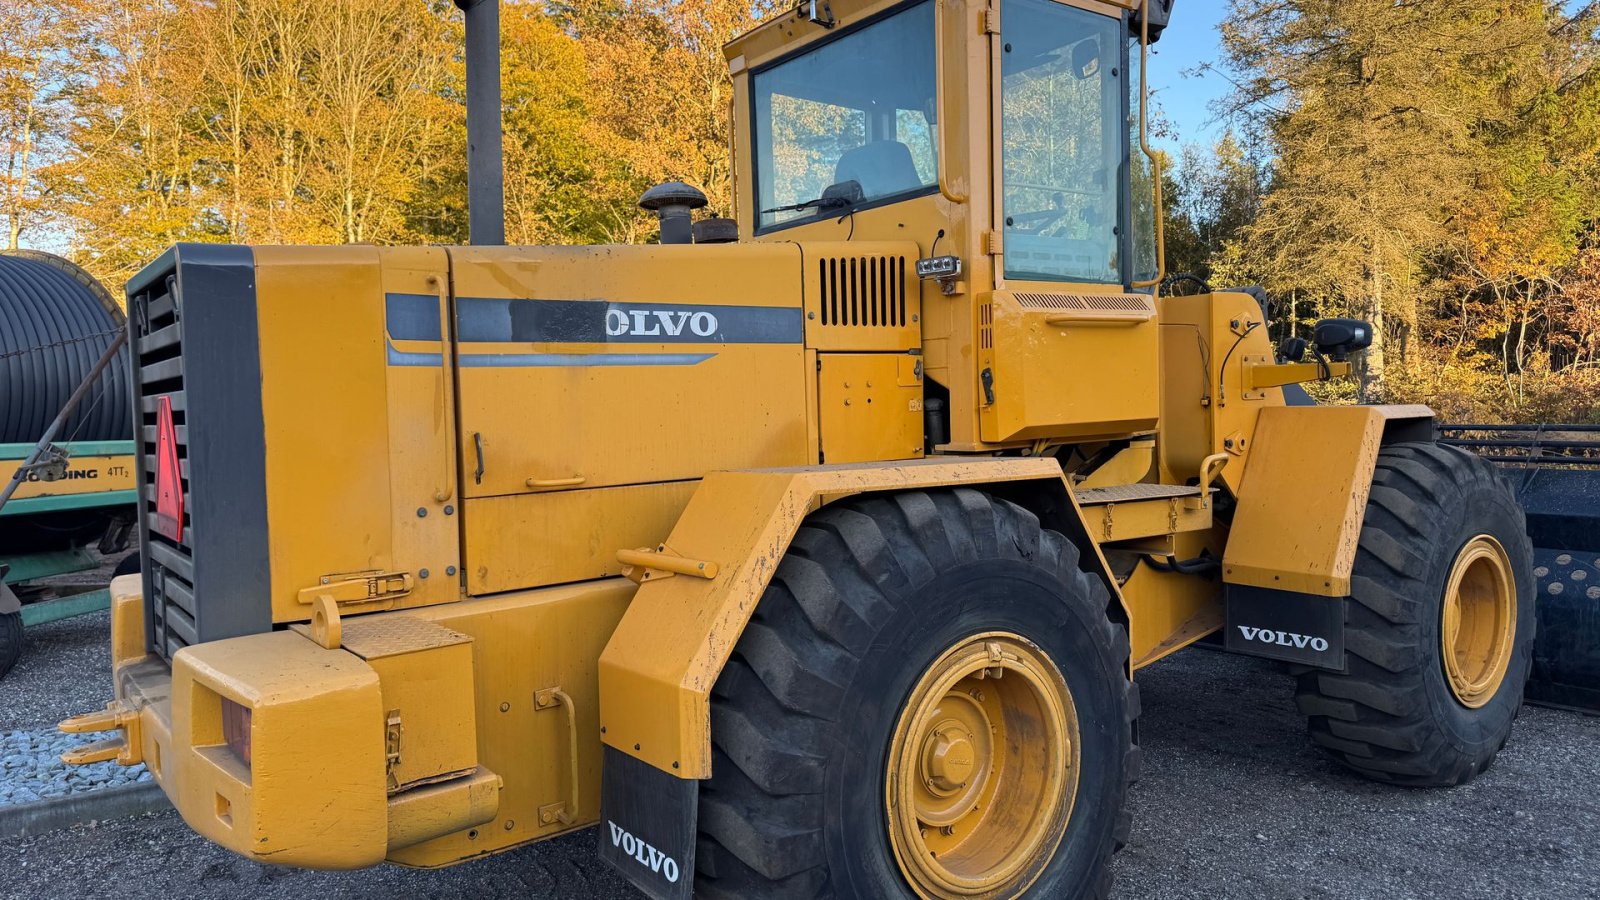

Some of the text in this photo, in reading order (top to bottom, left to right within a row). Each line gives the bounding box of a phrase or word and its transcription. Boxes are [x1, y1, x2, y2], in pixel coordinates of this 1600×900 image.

[606, 309, 718, 336] OLVO
[1237, 625, 1329, 652] VOLVO
[607, 819, 679, 883] VOLVO
